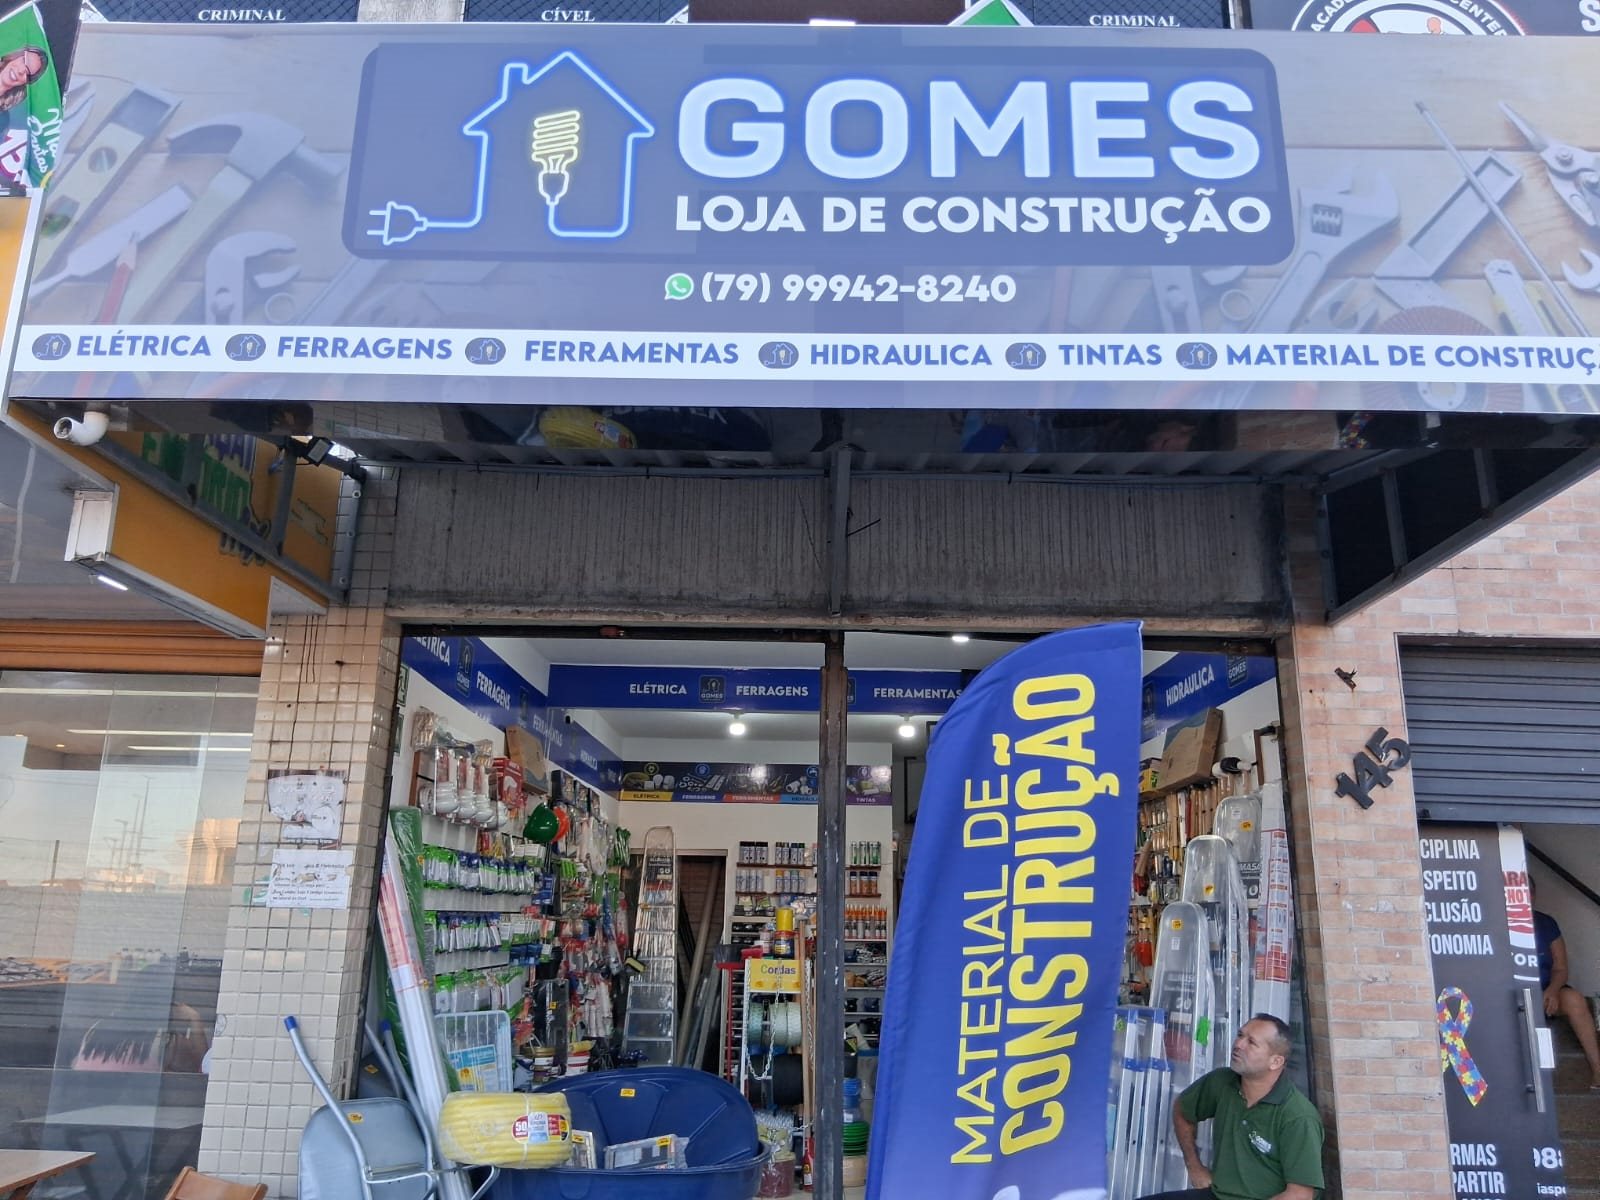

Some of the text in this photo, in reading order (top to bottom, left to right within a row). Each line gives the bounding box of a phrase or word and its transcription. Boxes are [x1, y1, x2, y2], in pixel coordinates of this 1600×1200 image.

[197, 9, 286, 21] CRIMINAL
[540, 7, 596, 22] CÍVEL
[1088, 14, 1180, 28] CRIMINAL
[679, 78, 1260, 180] GOMES
[676, 187, 1272, 244] LOJA DE CONSTRUÇÃO
[701, 273, 1017, 304] (79) 99942-8240
[76, 330, 1600, 377] ELÉTRICA FERRAGENS FERRAMENTAS HIDRAULICA TINTAS MATERIAL DE CONSTRUÇ
[1165, 663, 1216, 707] HIDRAULICA
[1228, 660, 1247, 679] GOMES
[476, 671, 511, 711] FERRAGENS
[628, 682, 687, 694] ELÉTRICA
[735, 684, 809, 697] FERRAGENS
[872, 687, 963, 700] FERRAMENTAS
[1334, 726, 1412, 810] 145
[992, 673, 1120, 1156] CONSTRUÇÃO
[760, 964, 796, 975] Cordas
[950, 772, 1010, 1165] MATERIAL DE
